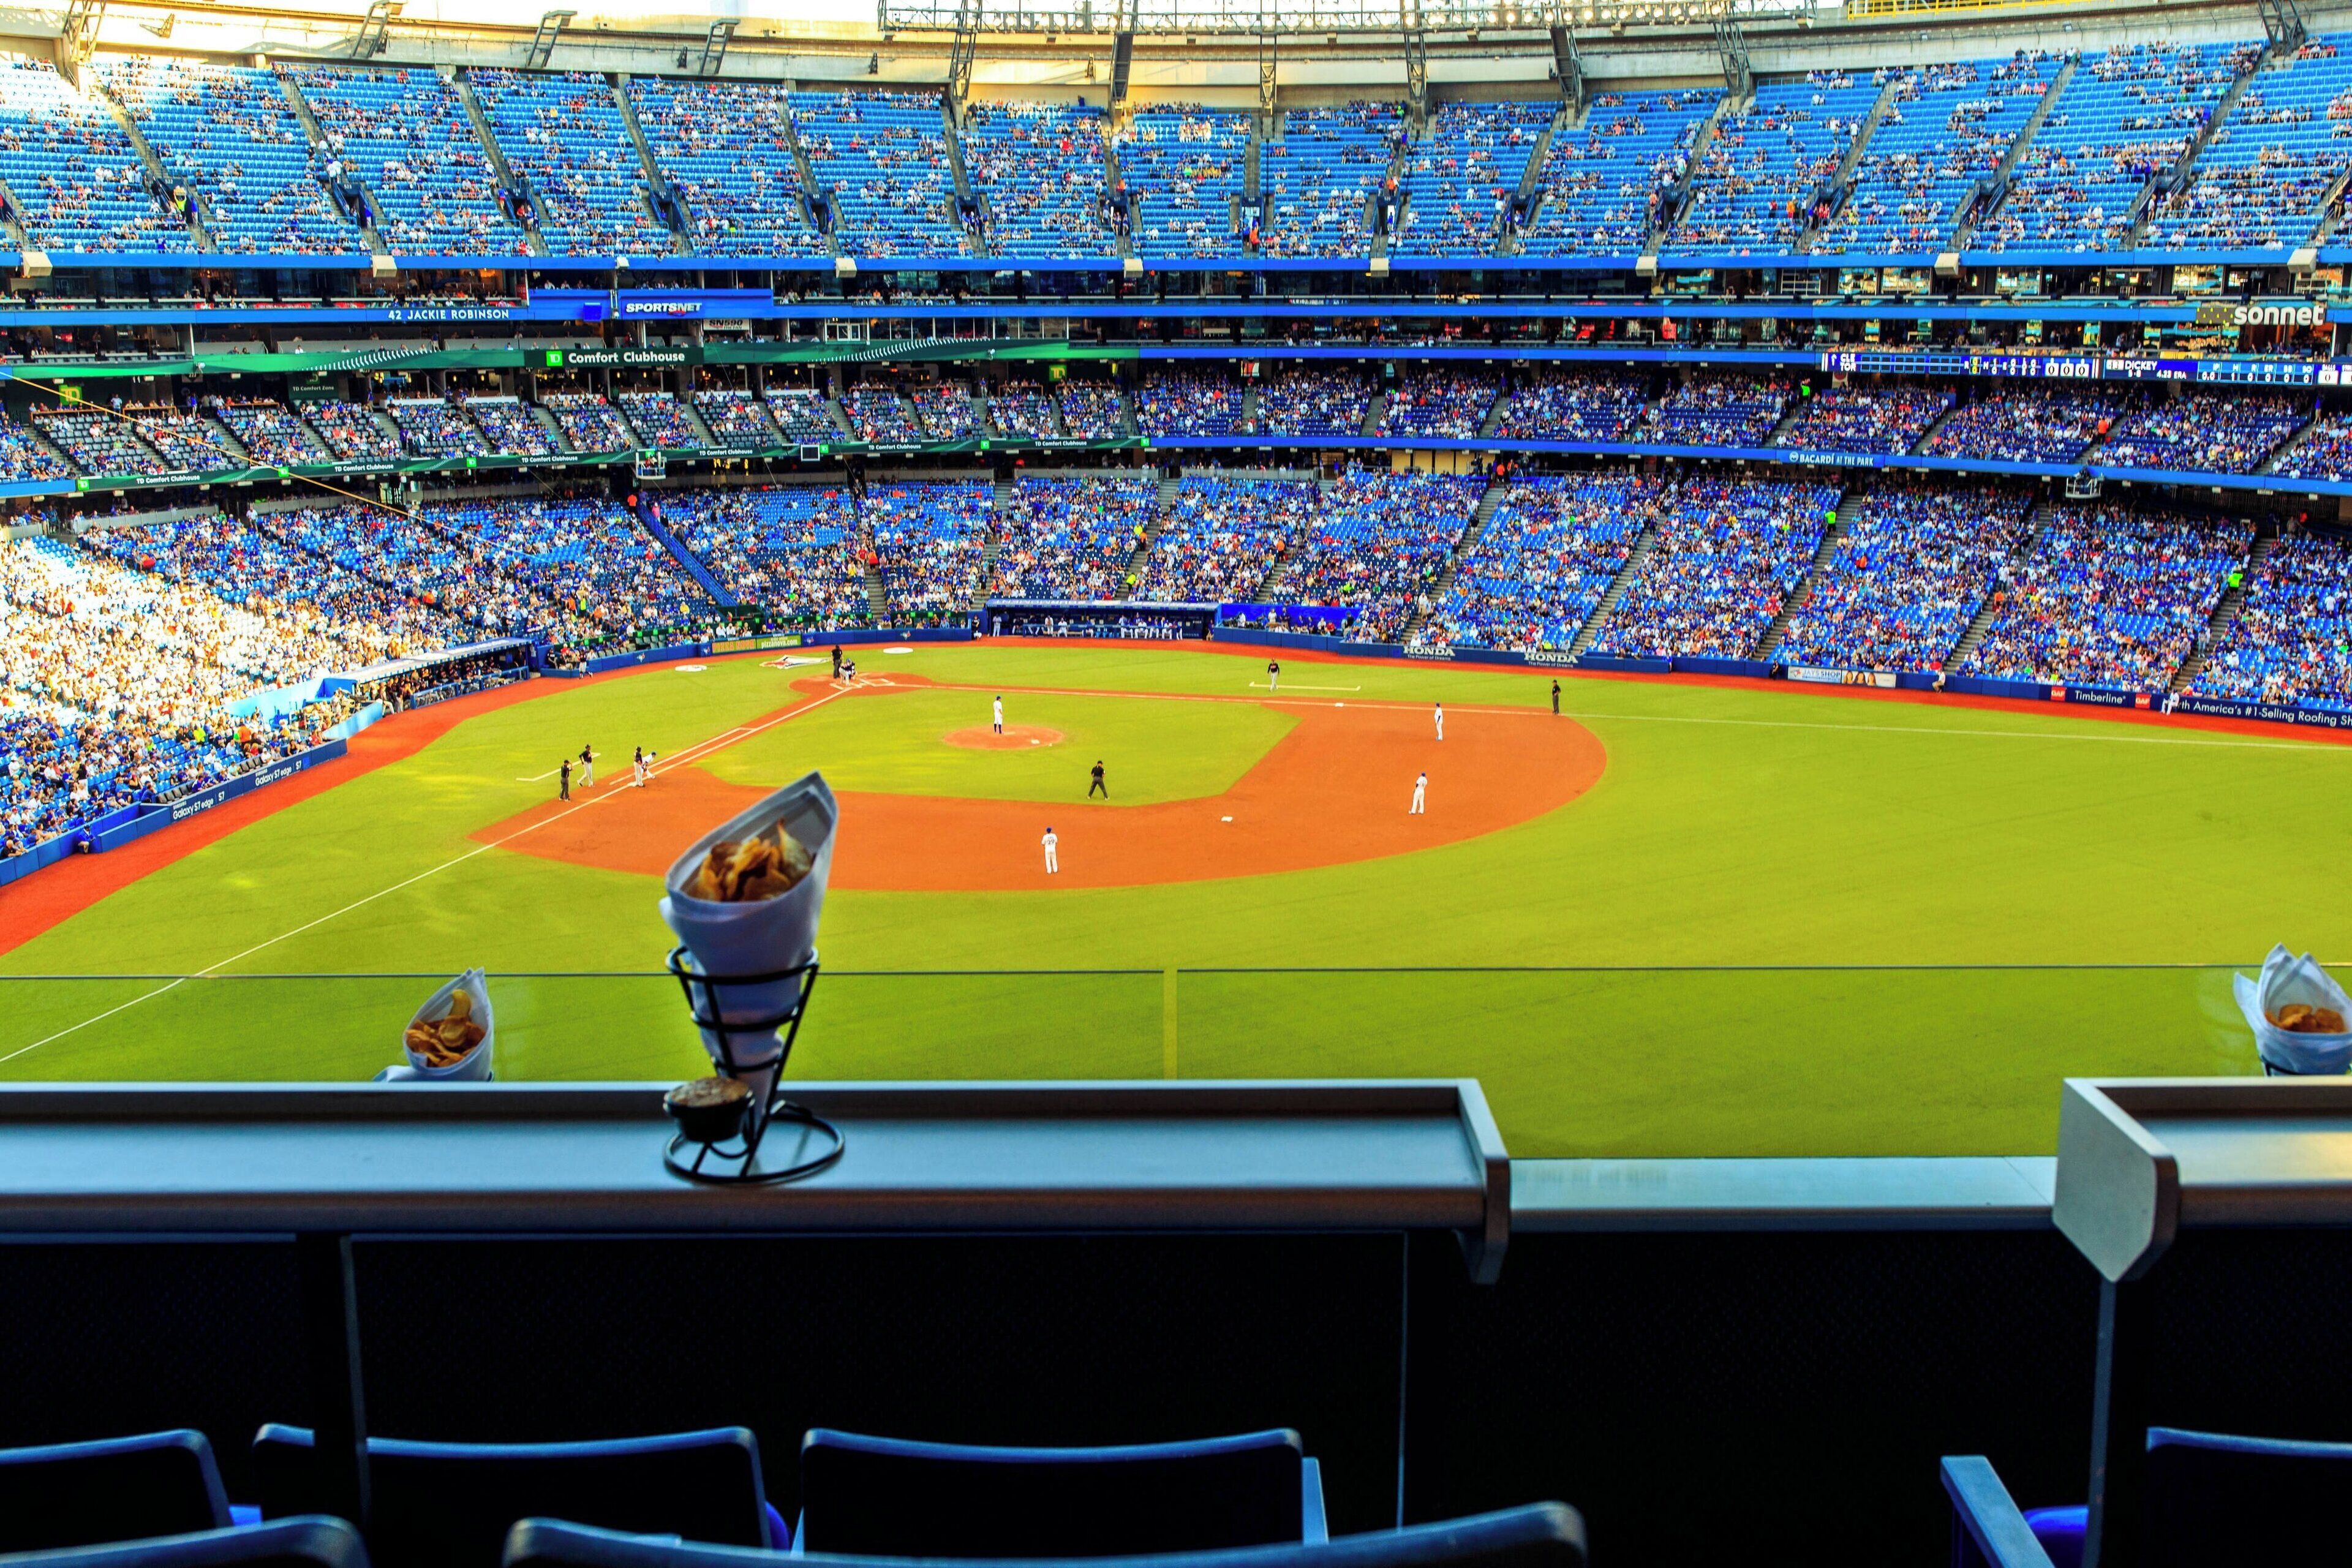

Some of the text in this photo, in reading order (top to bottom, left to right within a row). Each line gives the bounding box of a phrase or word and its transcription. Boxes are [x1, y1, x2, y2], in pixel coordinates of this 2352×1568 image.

[626, 303, 702, 313] SPORTSNET
[388, 309, 509, 320] 42 JACKIE ROBINSON
[2234, 305, 2324, 326] sonnet
[549, 352, 685, 363] TD Comfort Clubhouse
[1840, 353, 1856, 363] CLE
[1840, 363, 1856, 371] TOR
[2048, 366, 2085, 375] 0 0 0
[2125, 360, 2157, 371] DICKEY
[2174, 371, 2187, 380] ERA
[2202, 371, 2310, 383] 0.0 1 0 0 0 0
[1800, 453, 1835, 464] BACARDÍ
[1845, 456, 1855, 466] THE
[1857, 457, 1874, 467] PARK
[712, 639, 755, 653] PIZZA NOVA
[761, 639, 797, 649] pizzanova.com
[1403, 646, 1455, 657] HONDA
[1525, 652, 1578, 663] HONDA
[2193, 702, 2242, 715] America's
[2245, 707, 2294, 723] #1-Selling
[2298, 710, 2337, 727] Roofing
[255, 761, 301, 786] Galaxy S7 edge S7
[173, 791, 225, 820] Galaxy S7 edge S7
